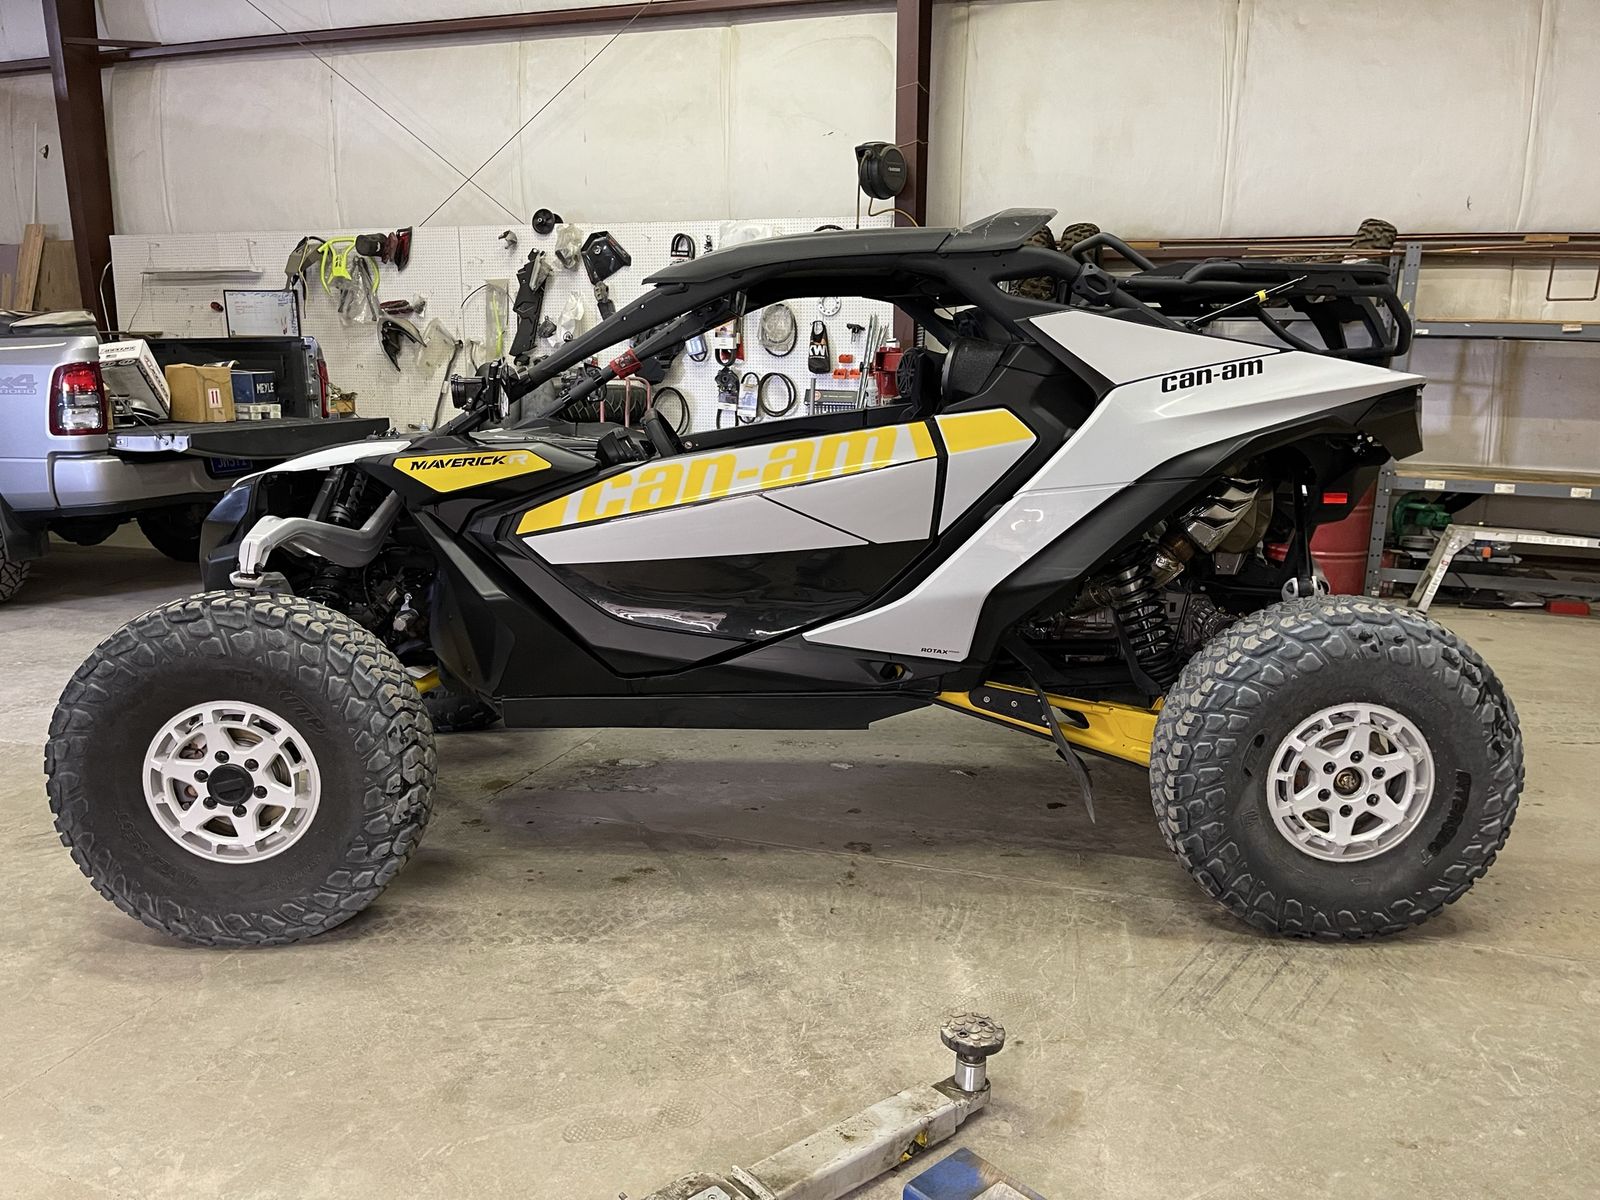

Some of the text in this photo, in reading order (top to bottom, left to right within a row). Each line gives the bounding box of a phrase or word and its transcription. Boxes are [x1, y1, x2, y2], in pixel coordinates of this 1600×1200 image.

[1161, 359, 1263, 393] can-am
[256, 382, 275, 394] MEYLE
[410, 455, 508, 471] MAVERICK
[577, 425, 899, 523] can-am
[920, 647, 948, 655] ROTAX
